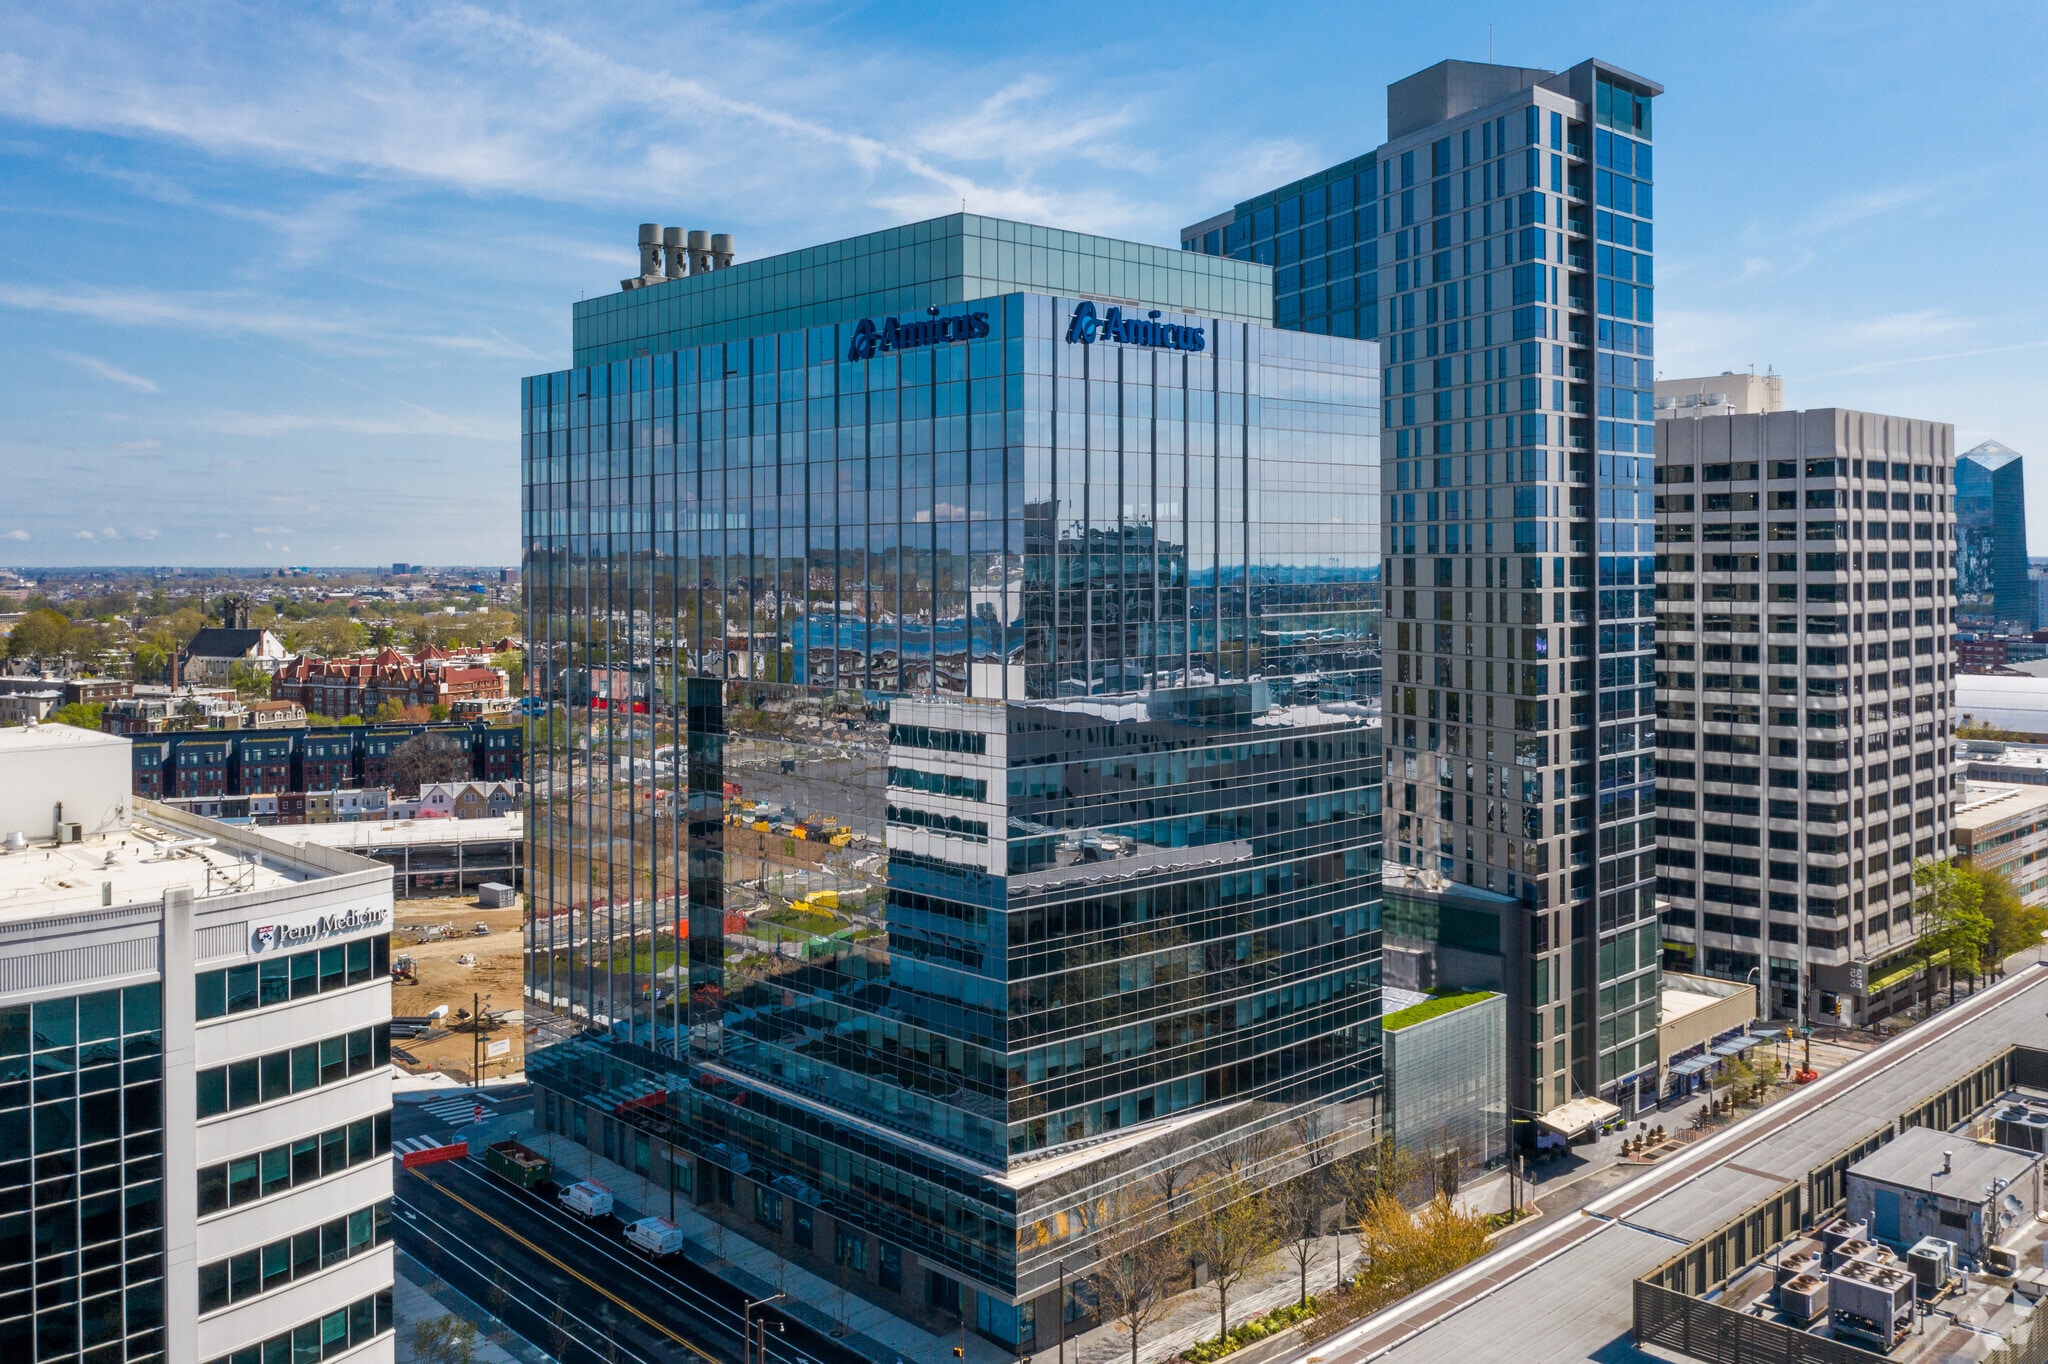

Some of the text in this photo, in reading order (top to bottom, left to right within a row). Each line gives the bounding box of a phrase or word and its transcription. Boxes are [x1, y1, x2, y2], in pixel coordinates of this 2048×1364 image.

[878, 306, 990, 352] Amicus
[1100, 307, 1205, 351] Amicus
[280, 907, 388, 941] Penn Medicine
[1849, 979, 1863, 989] 35
